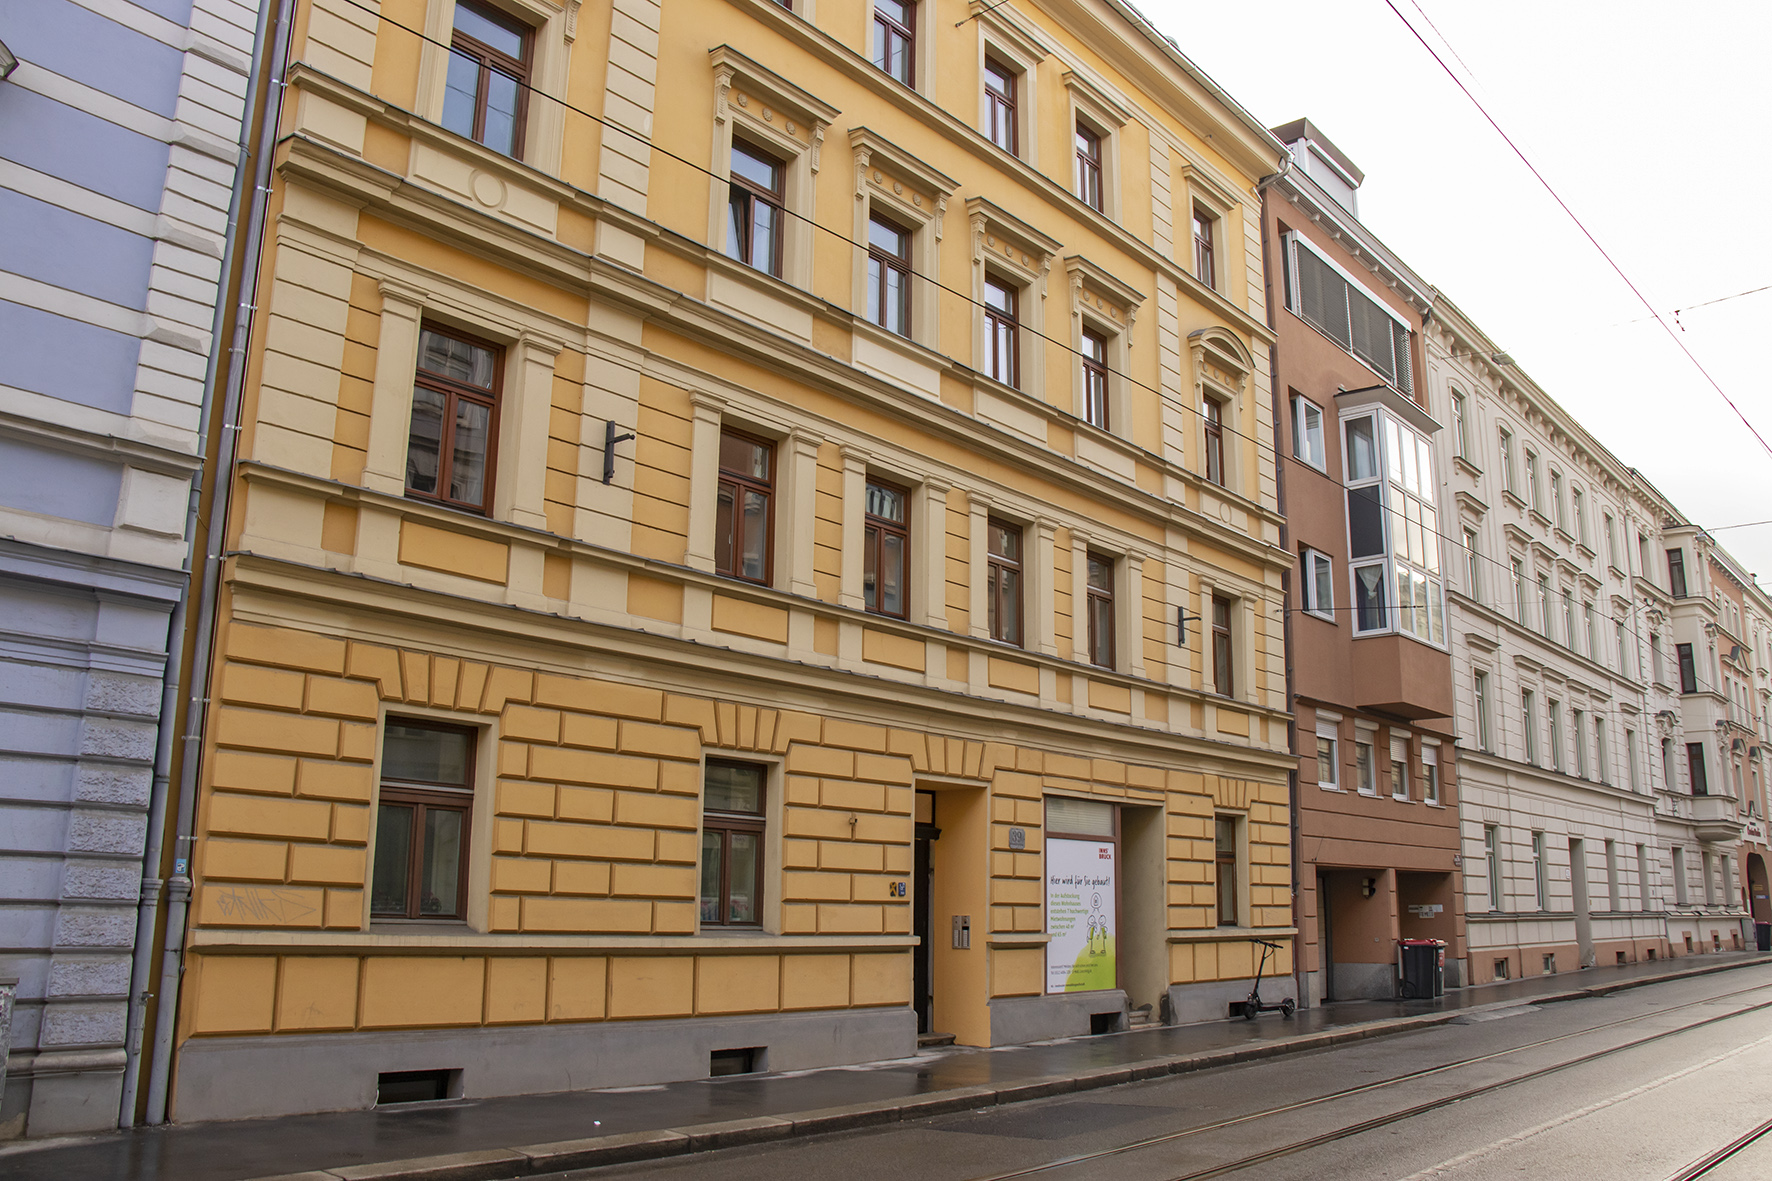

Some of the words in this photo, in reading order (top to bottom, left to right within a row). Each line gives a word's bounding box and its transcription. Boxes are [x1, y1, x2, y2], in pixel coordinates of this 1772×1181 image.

[1011, 831, 1022, 842] 39
[1050, 875, 1060, 885] Hier
[1062, 875, 1073, 885] wird
[1075, 875, 1083, 889] für
[1092, 875, 1110, 890] gebaut!
